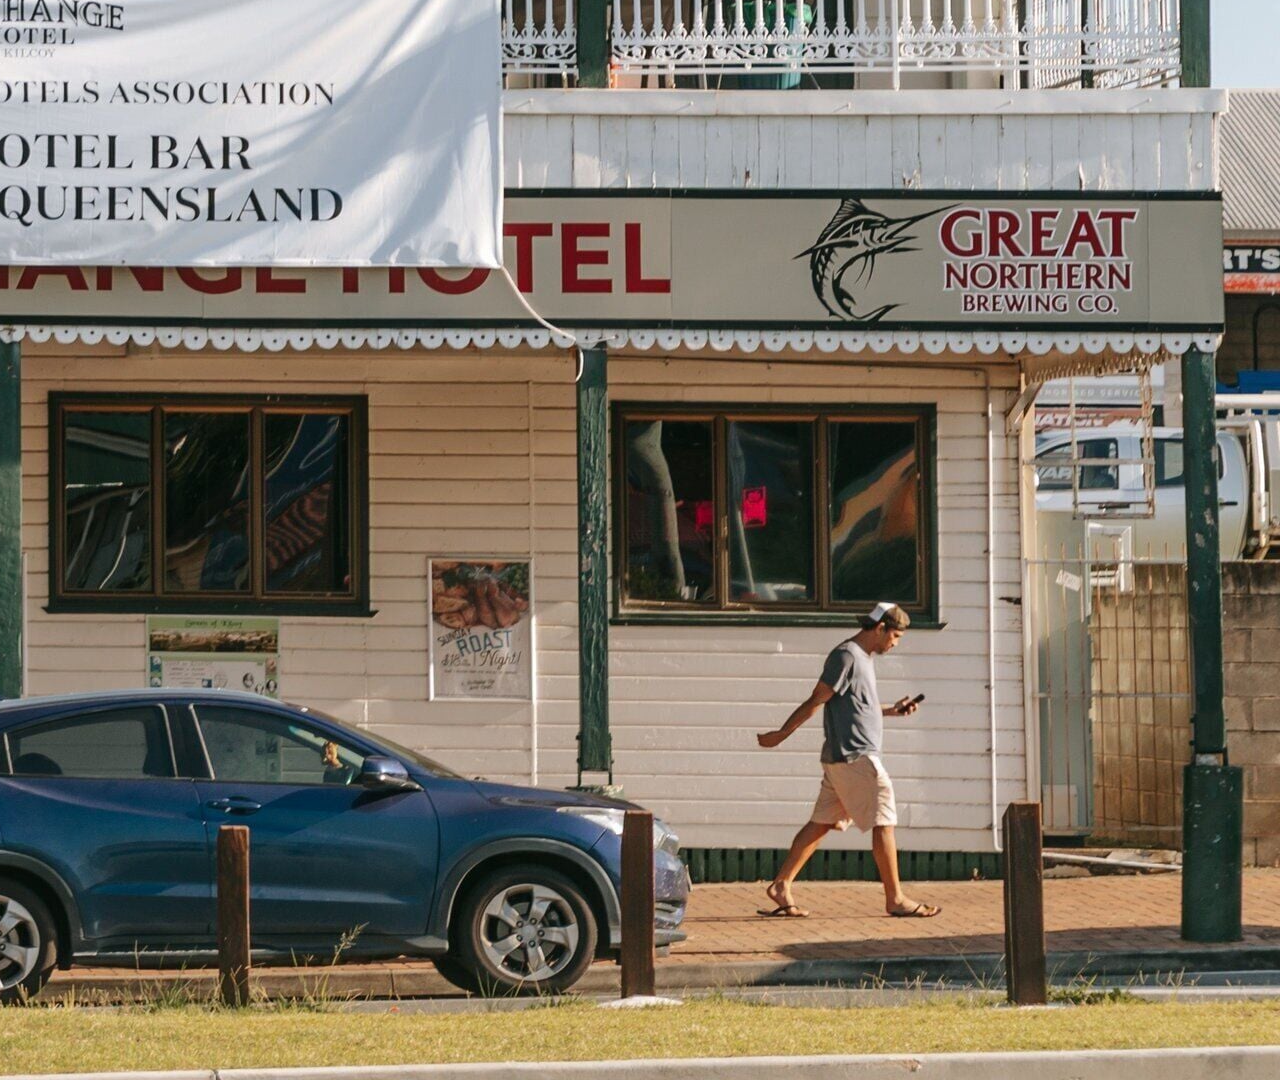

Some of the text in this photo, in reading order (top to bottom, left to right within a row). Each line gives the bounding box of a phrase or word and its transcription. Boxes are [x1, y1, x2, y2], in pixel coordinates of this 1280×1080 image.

[4, 48, 56, 58] KILCOY
[109, 81, 335, 106] ASSOCIATION
[150, 134, 253, 171] BAR
[940, 209, 1138, 258] GREAT
[944, 262, 1131, 290] NORTHERN
[962, 294, 1119, 313] BREWING CO.
[437, 628, 472, 647] SUNDAY
[456, 629, 513, 657] ROAST
[479, 649, 522, 670] Night!
